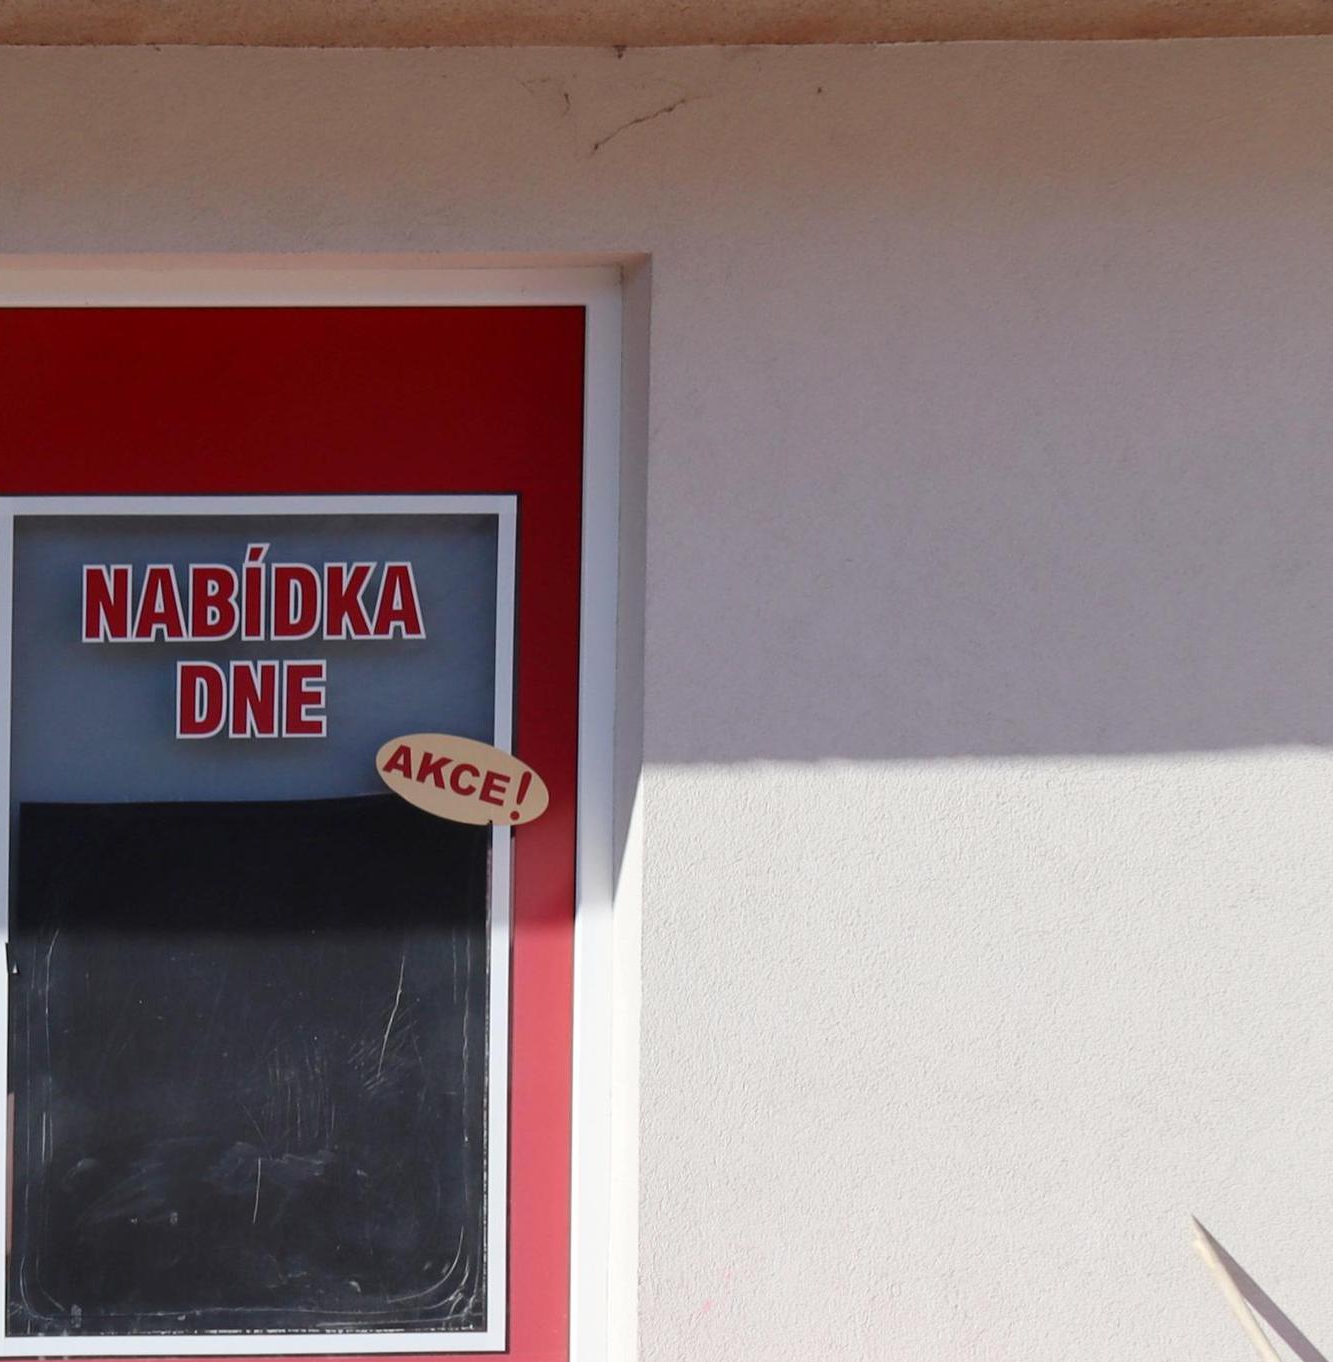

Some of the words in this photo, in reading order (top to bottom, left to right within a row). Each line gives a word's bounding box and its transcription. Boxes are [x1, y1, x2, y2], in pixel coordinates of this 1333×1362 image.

[82, 543, 426, 643] NABÍDKA
[176, 660, 327, 739] DNE
[382, 743, 533, 822] AKCE!
